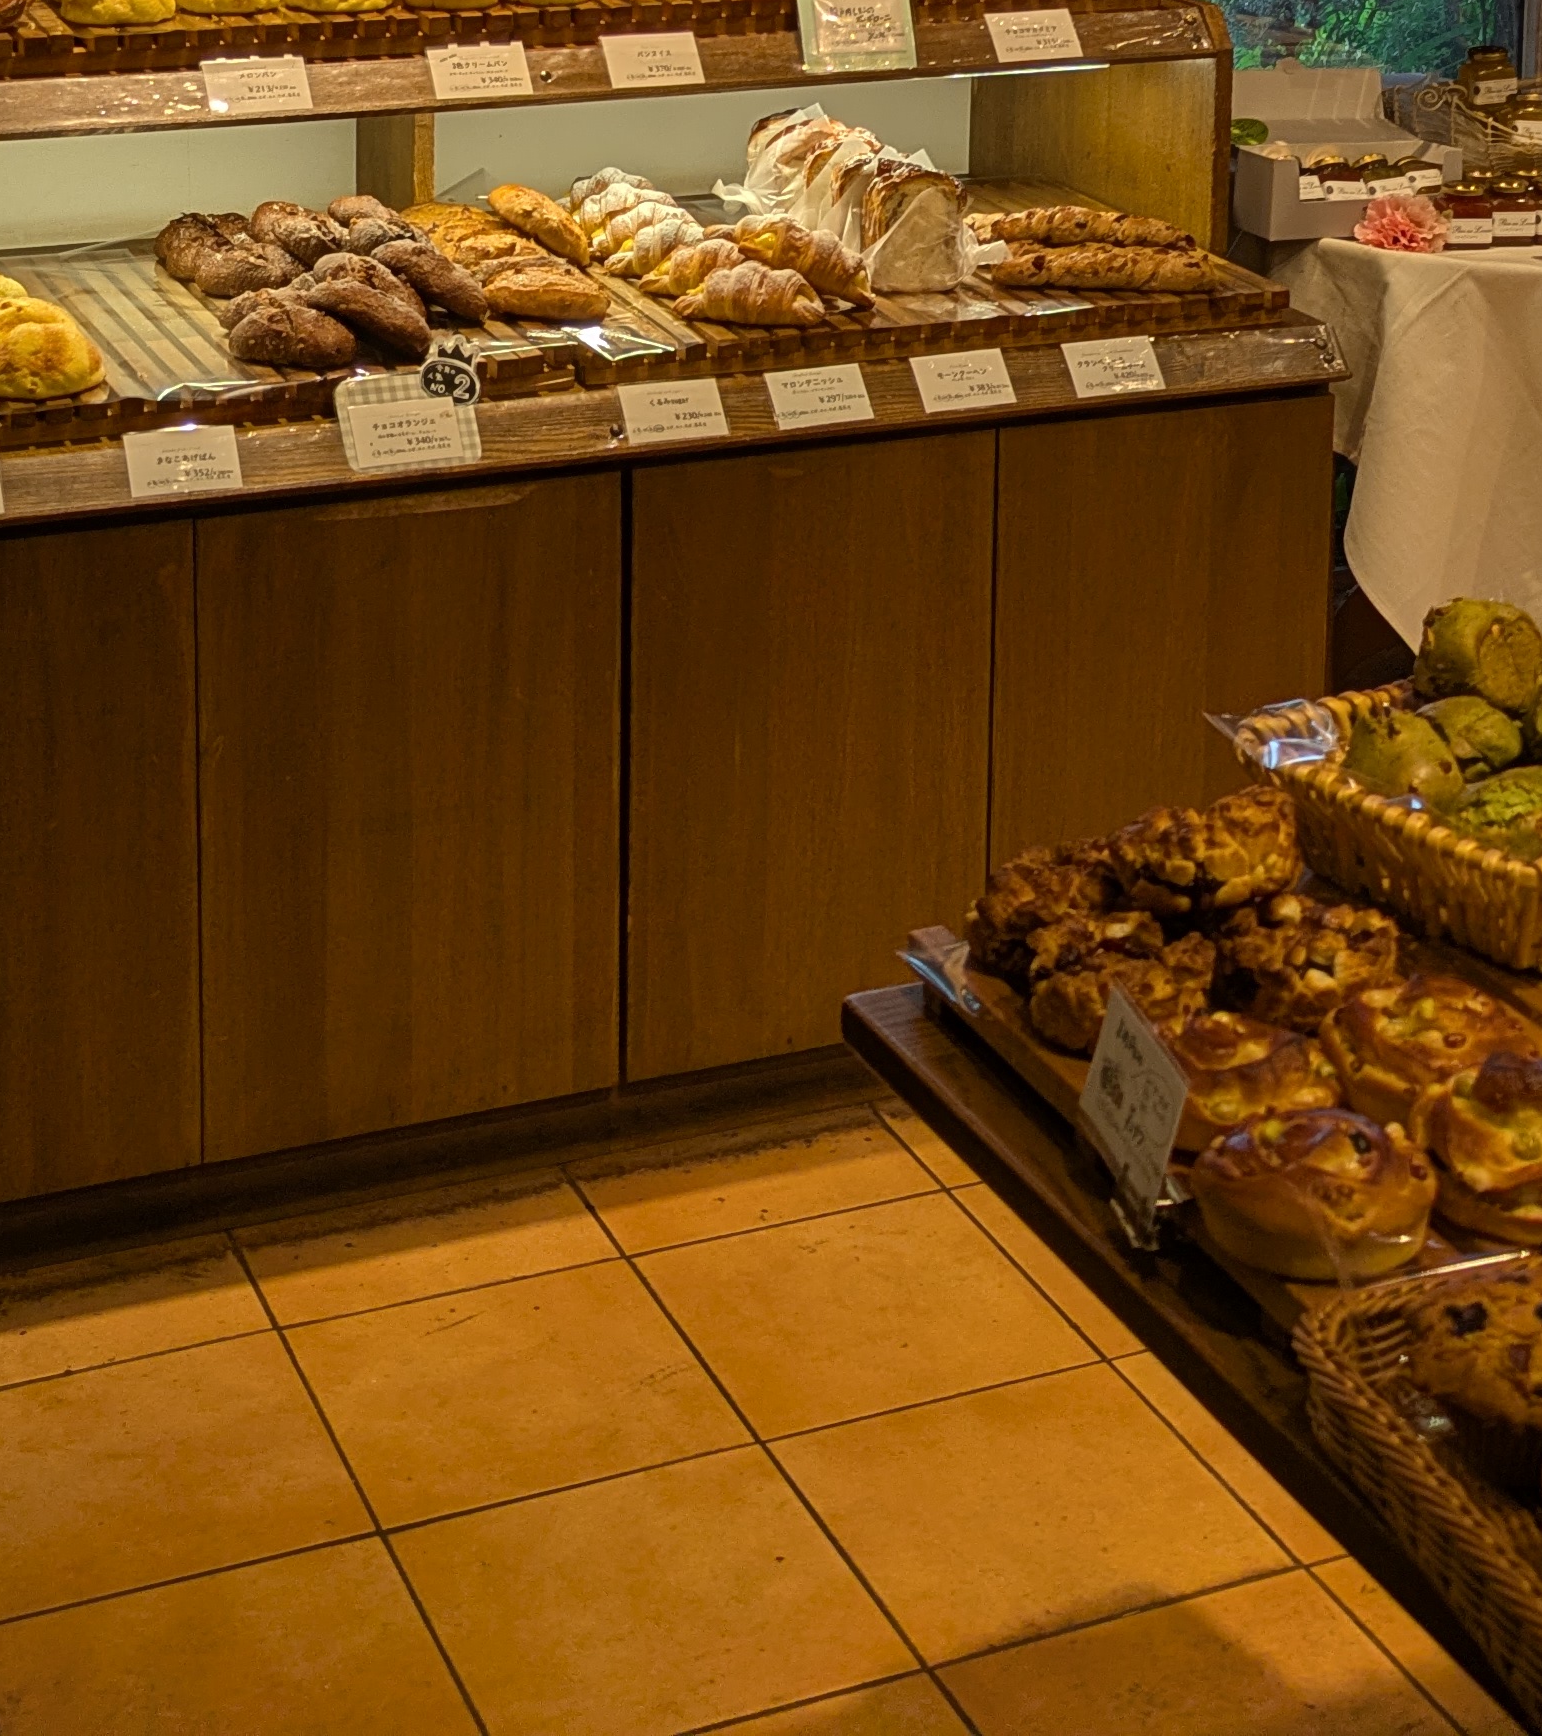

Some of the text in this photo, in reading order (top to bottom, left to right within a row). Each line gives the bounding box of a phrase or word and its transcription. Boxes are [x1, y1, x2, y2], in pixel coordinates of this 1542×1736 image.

[238, 70, 278, 80] メロンパン
[452, 373, 471, 400] 2
[781, 376, 844, 390] マロンデニッシュ
[372, 418, 436, 432] チョコオランジェ
[156, 452, 217, 466] きなこあげぱん
